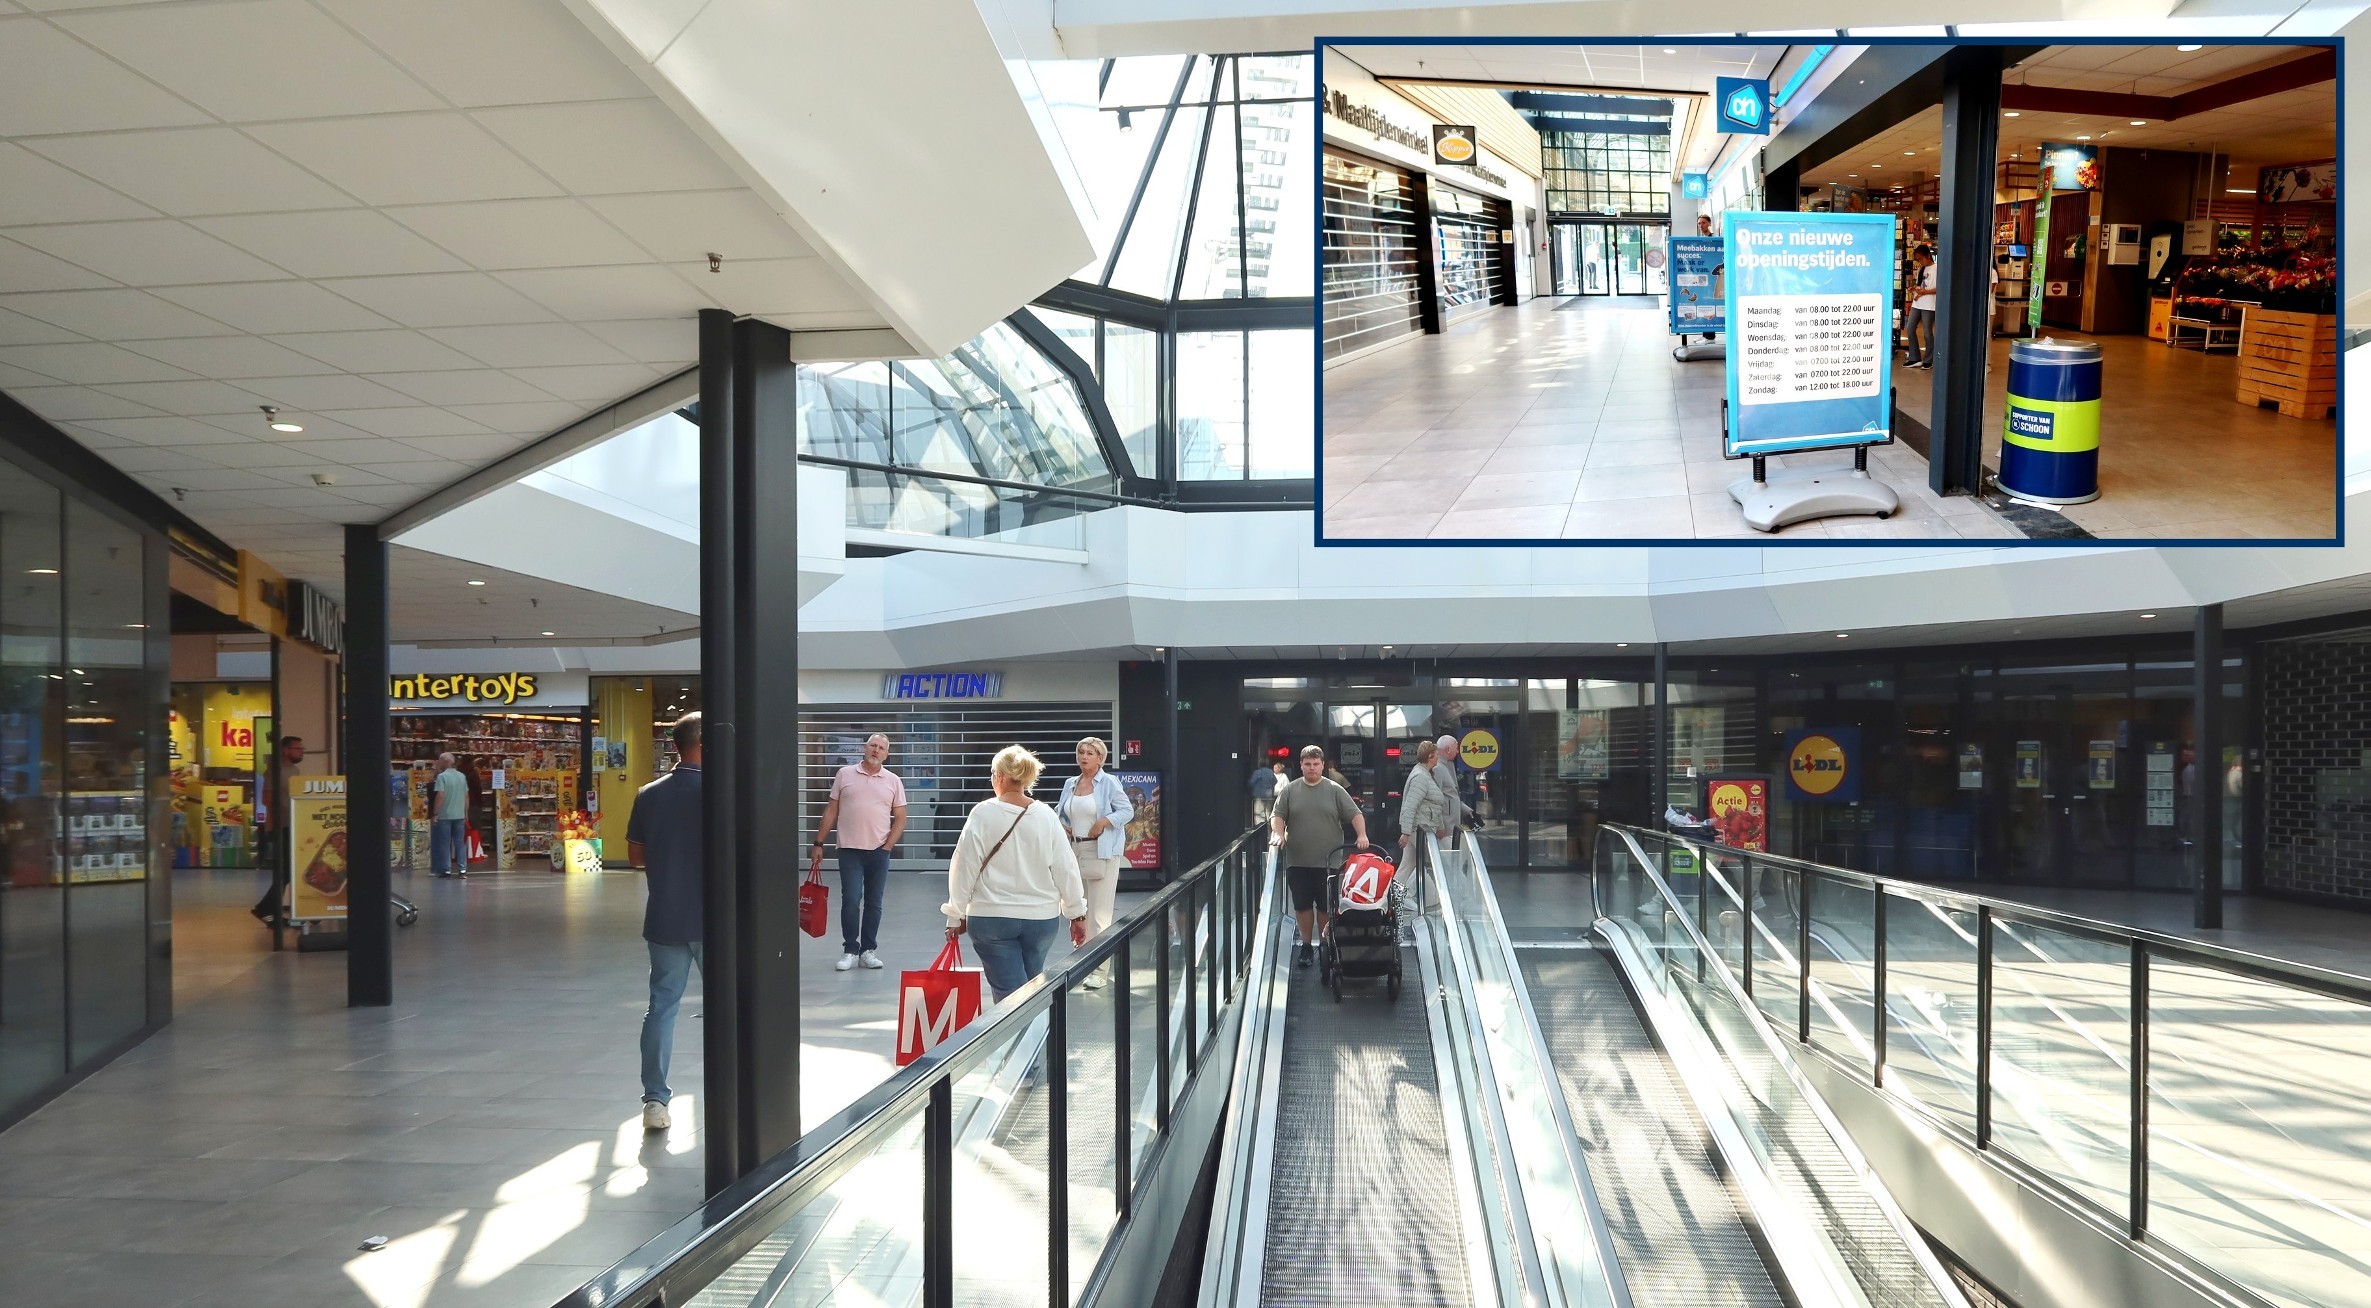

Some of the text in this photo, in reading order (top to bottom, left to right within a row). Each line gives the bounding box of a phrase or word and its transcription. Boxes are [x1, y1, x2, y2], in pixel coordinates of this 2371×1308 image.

[1735, 228, 1853, 245] Onze nieuwe
[1736, 250, 1871, 270] openingstijden.
[2012, 411, 2050, 424] SUPPORTER VAN
[2020, 421, 2050, 435] SCHOON
[897, 673, 988, 699] ACTION
[1120, 775, 1157, 783] MEXICANA
[303, 780, 347, 794] JUM
[1716, 796, 1743, 806] Actie
[900, 986, 979, 1054] M
